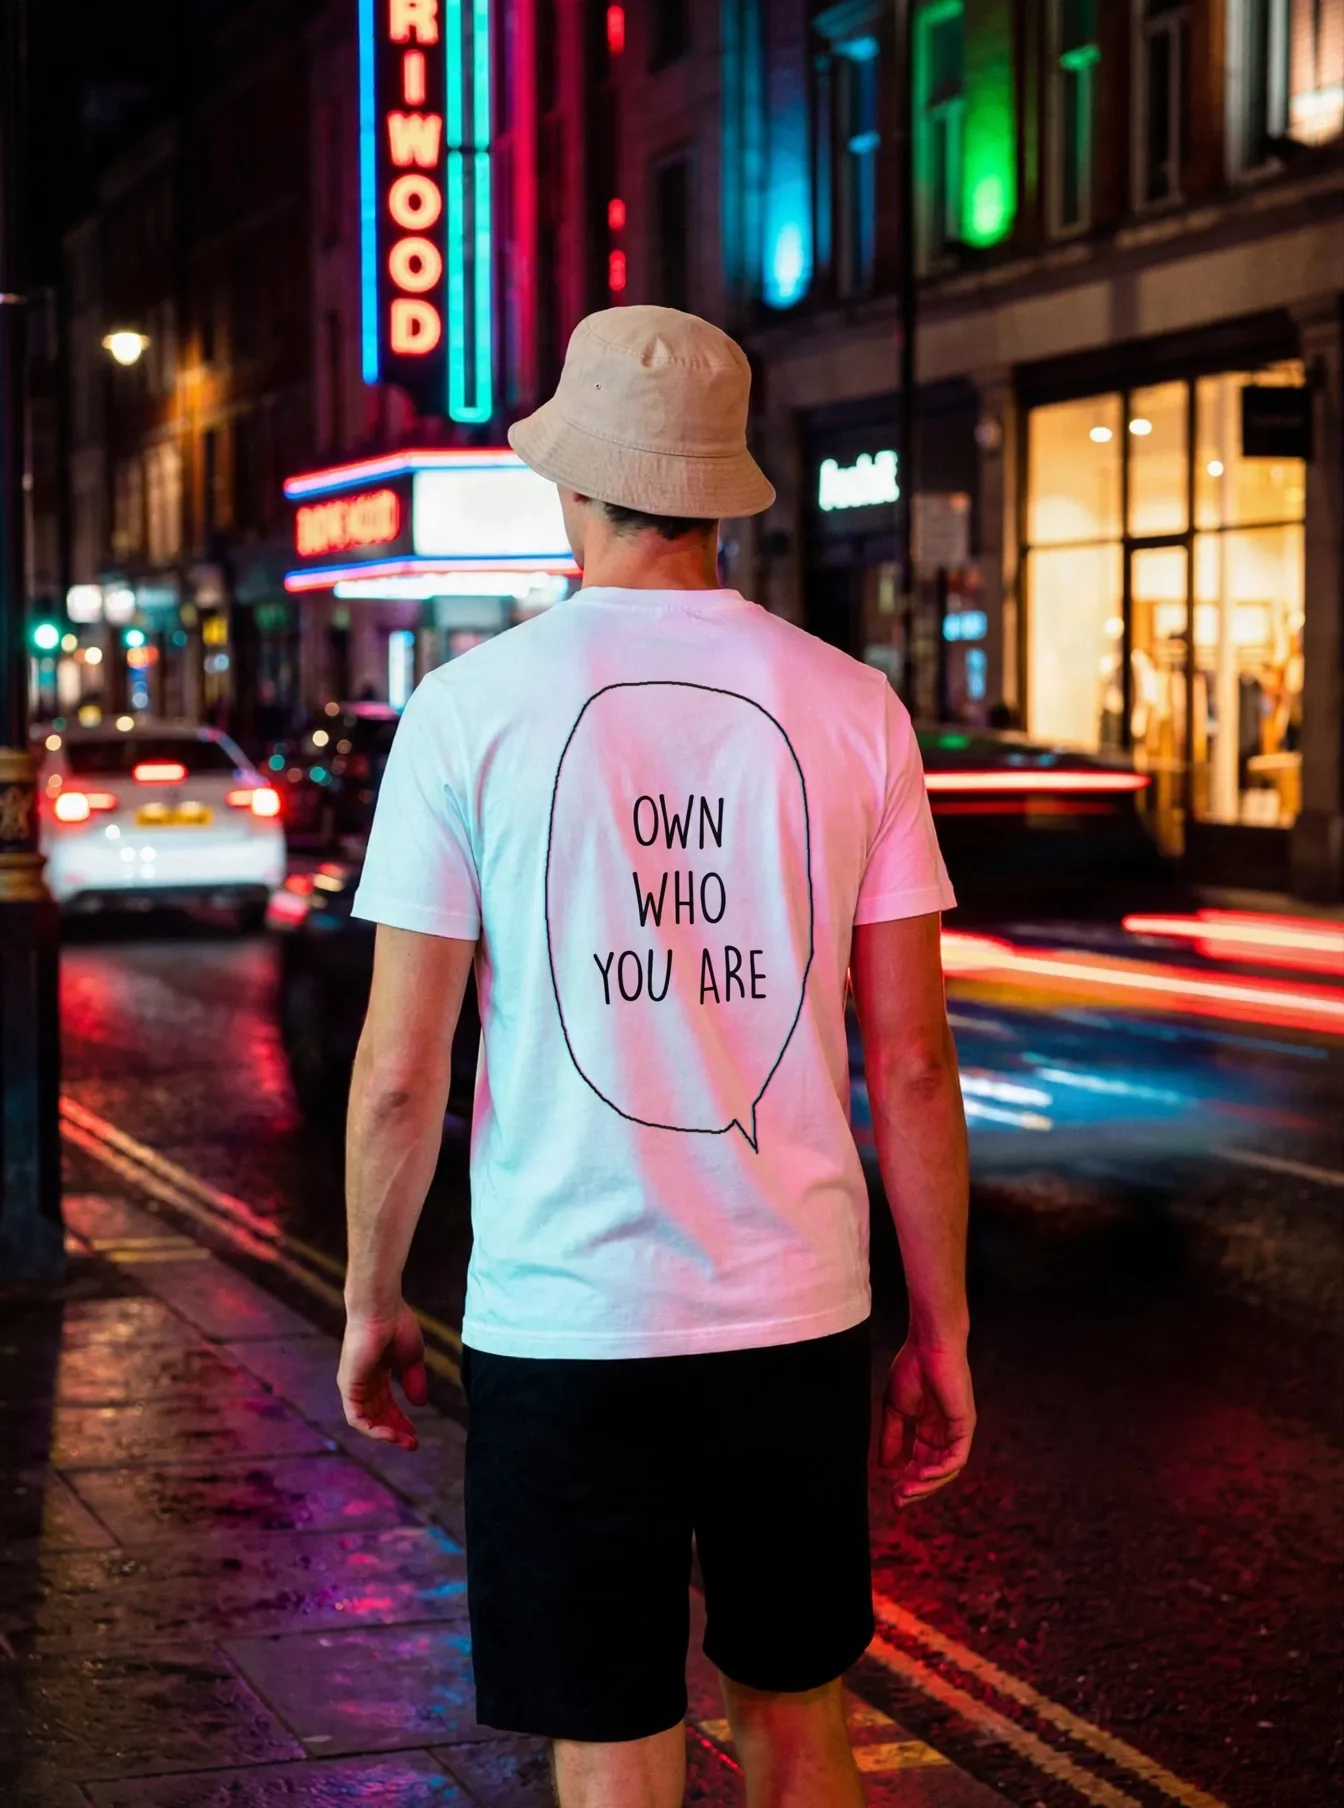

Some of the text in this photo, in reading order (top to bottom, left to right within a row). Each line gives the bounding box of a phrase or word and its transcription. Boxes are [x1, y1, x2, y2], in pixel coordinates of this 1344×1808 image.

[633, 792, 724, 850] OWN
[632, 870, 726, 928] WHO
[593, 945, 767, 1005] YOU ARE
